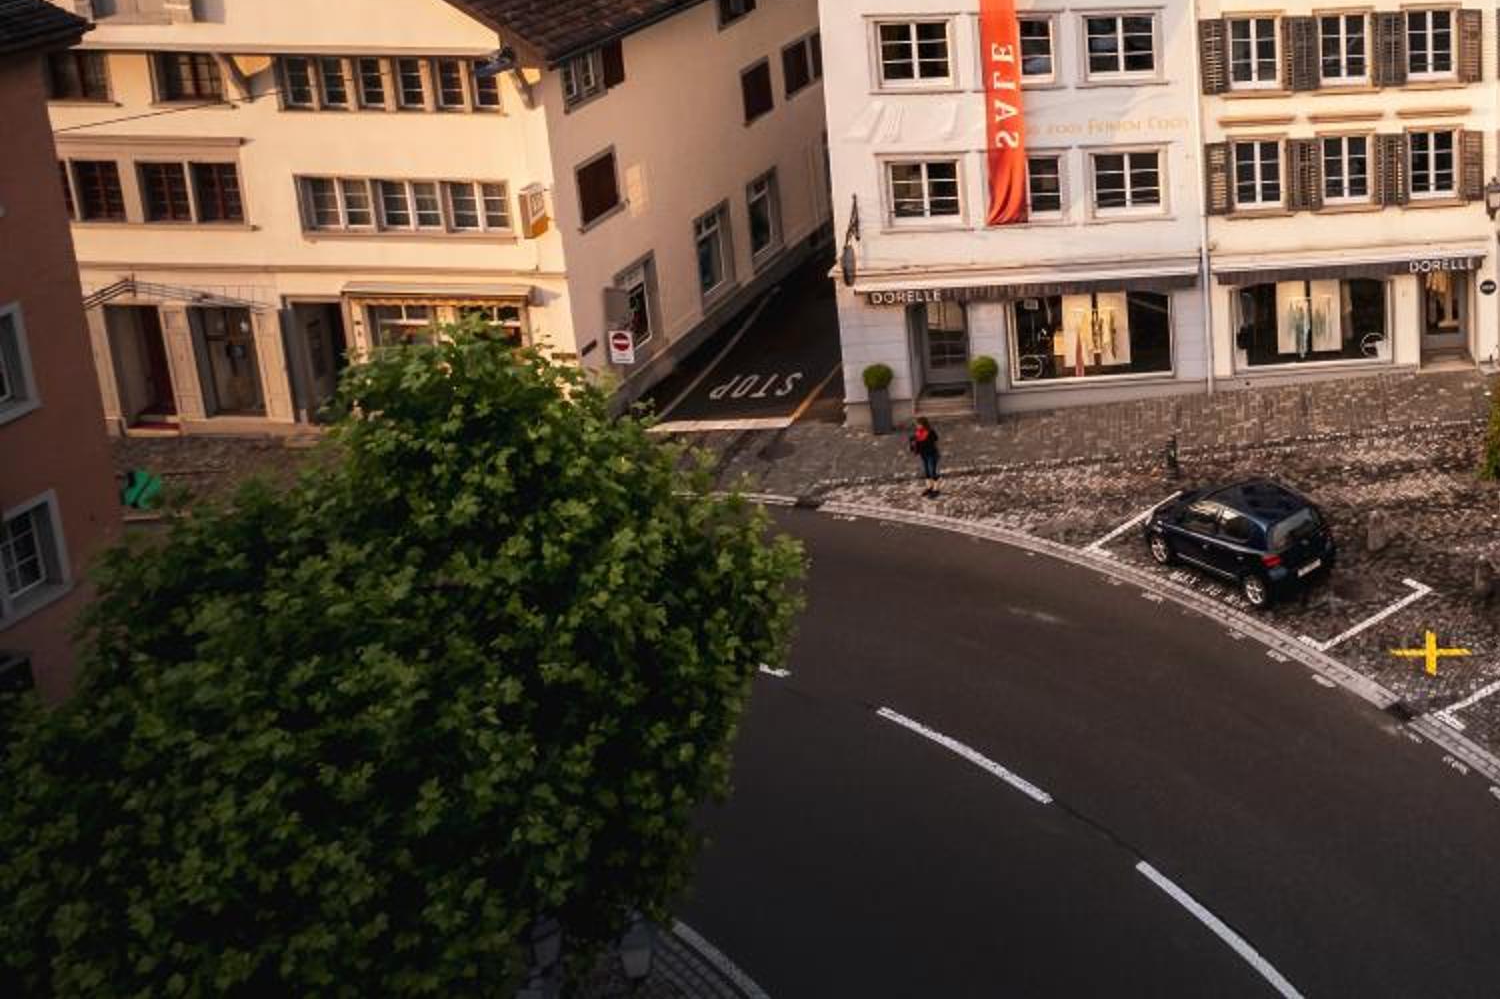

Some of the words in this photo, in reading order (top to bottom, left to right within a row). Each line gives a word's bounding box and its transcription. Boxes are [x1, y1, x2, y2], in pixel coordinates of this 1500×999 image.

[1409, 258, 1475, 273] DORELLE
[871, 289, 941, 304] DORELLE
[709, 371, 803, 400] STOP
